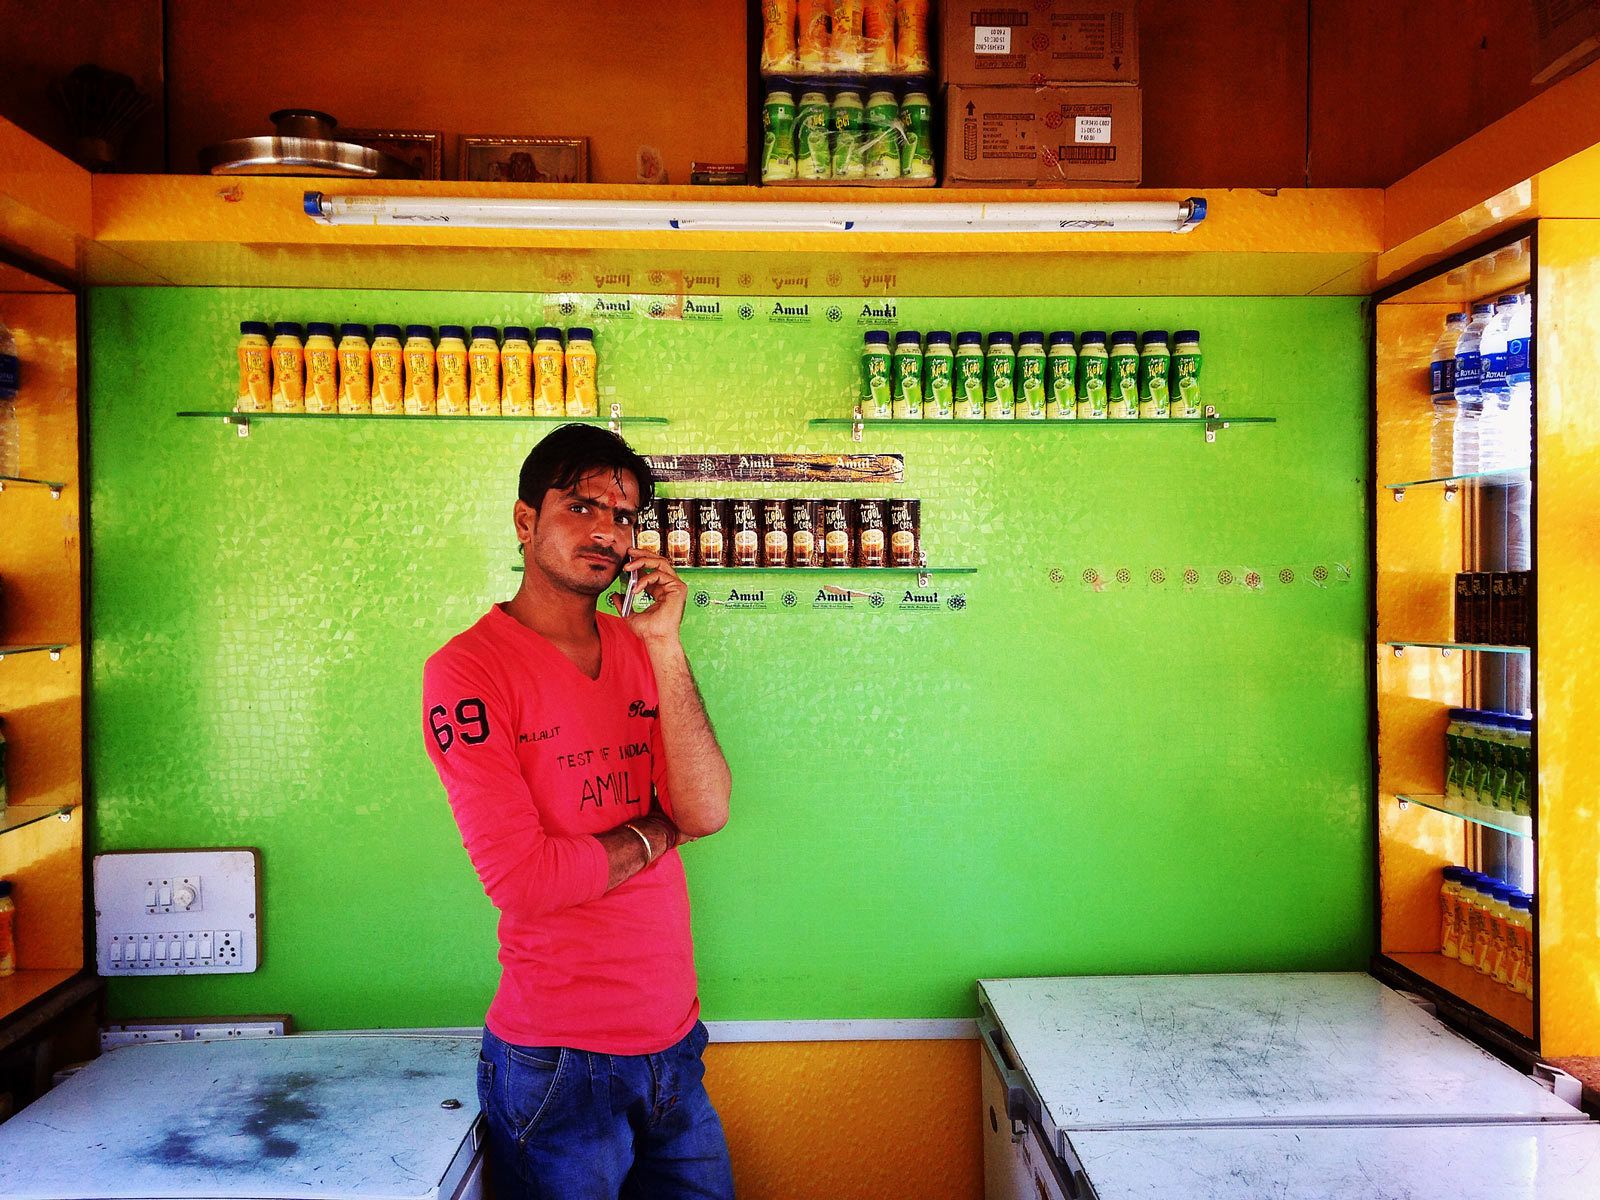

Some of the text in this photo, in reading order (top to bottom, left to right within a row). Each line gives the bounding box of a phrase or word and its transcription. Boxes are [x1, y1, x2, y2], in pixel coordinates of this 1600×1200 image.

[593, 298, 631, 311] Amul
[684, 300, 720, 313] Amul
[771, 302, 808, 315] Amul
[738, 456, 775, 469] Amul
[835, 457, 871, 469] Amul
[727, 589, 764, 602] Amul
[815, 589, 851, 602] Amul
[902, 590, 938, 603] Amul
[429, 697, 490, 755] 69
[557, 750, 594, 771] TEST
[619, 742, 650, 760] INDIA
